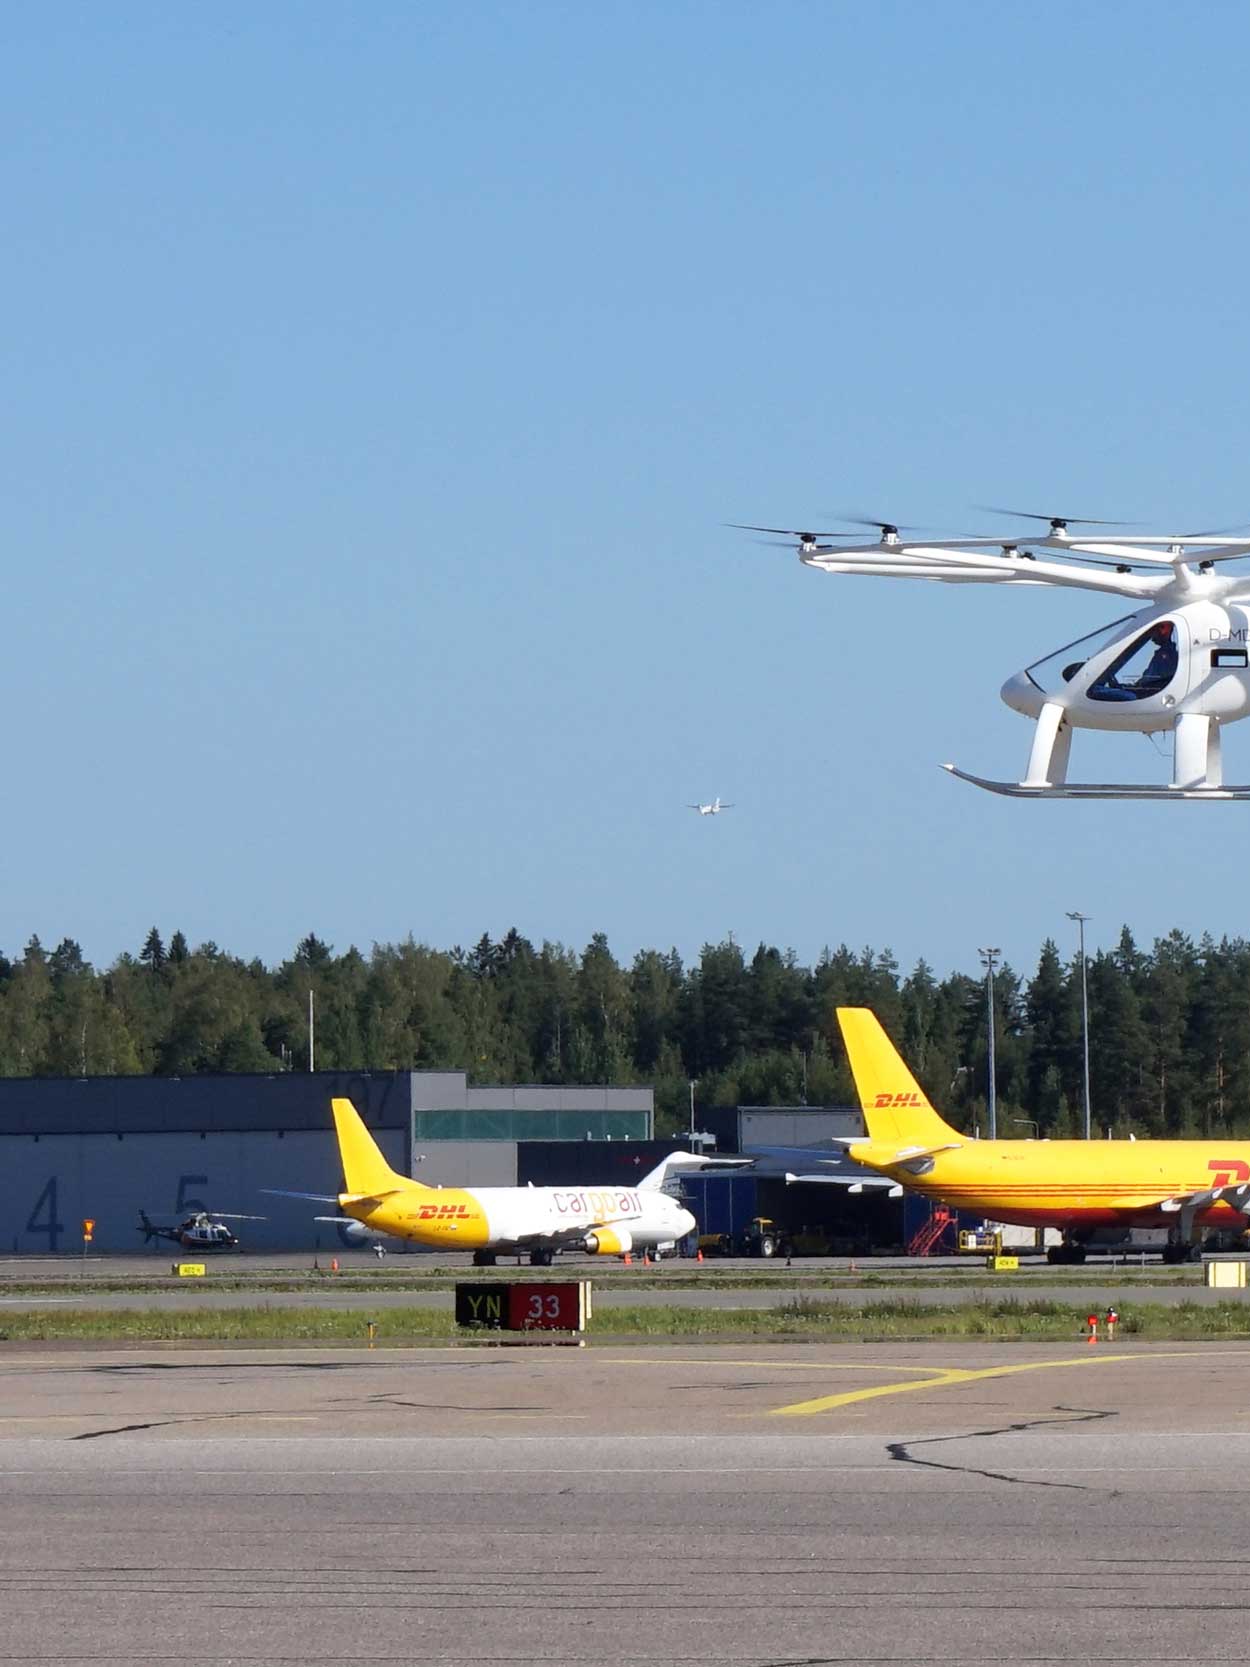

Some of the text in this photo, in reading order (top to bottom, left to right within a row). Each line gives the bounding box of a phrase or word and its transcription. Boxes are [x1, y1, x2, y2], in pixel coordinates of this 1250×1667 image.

[875, 1093, 921, 1108] DHL
[26, 1176, 64, 1250] 4
[419, 1205, 470, 1219] DHL
[468, 1295, 560, 1318] YN 33
